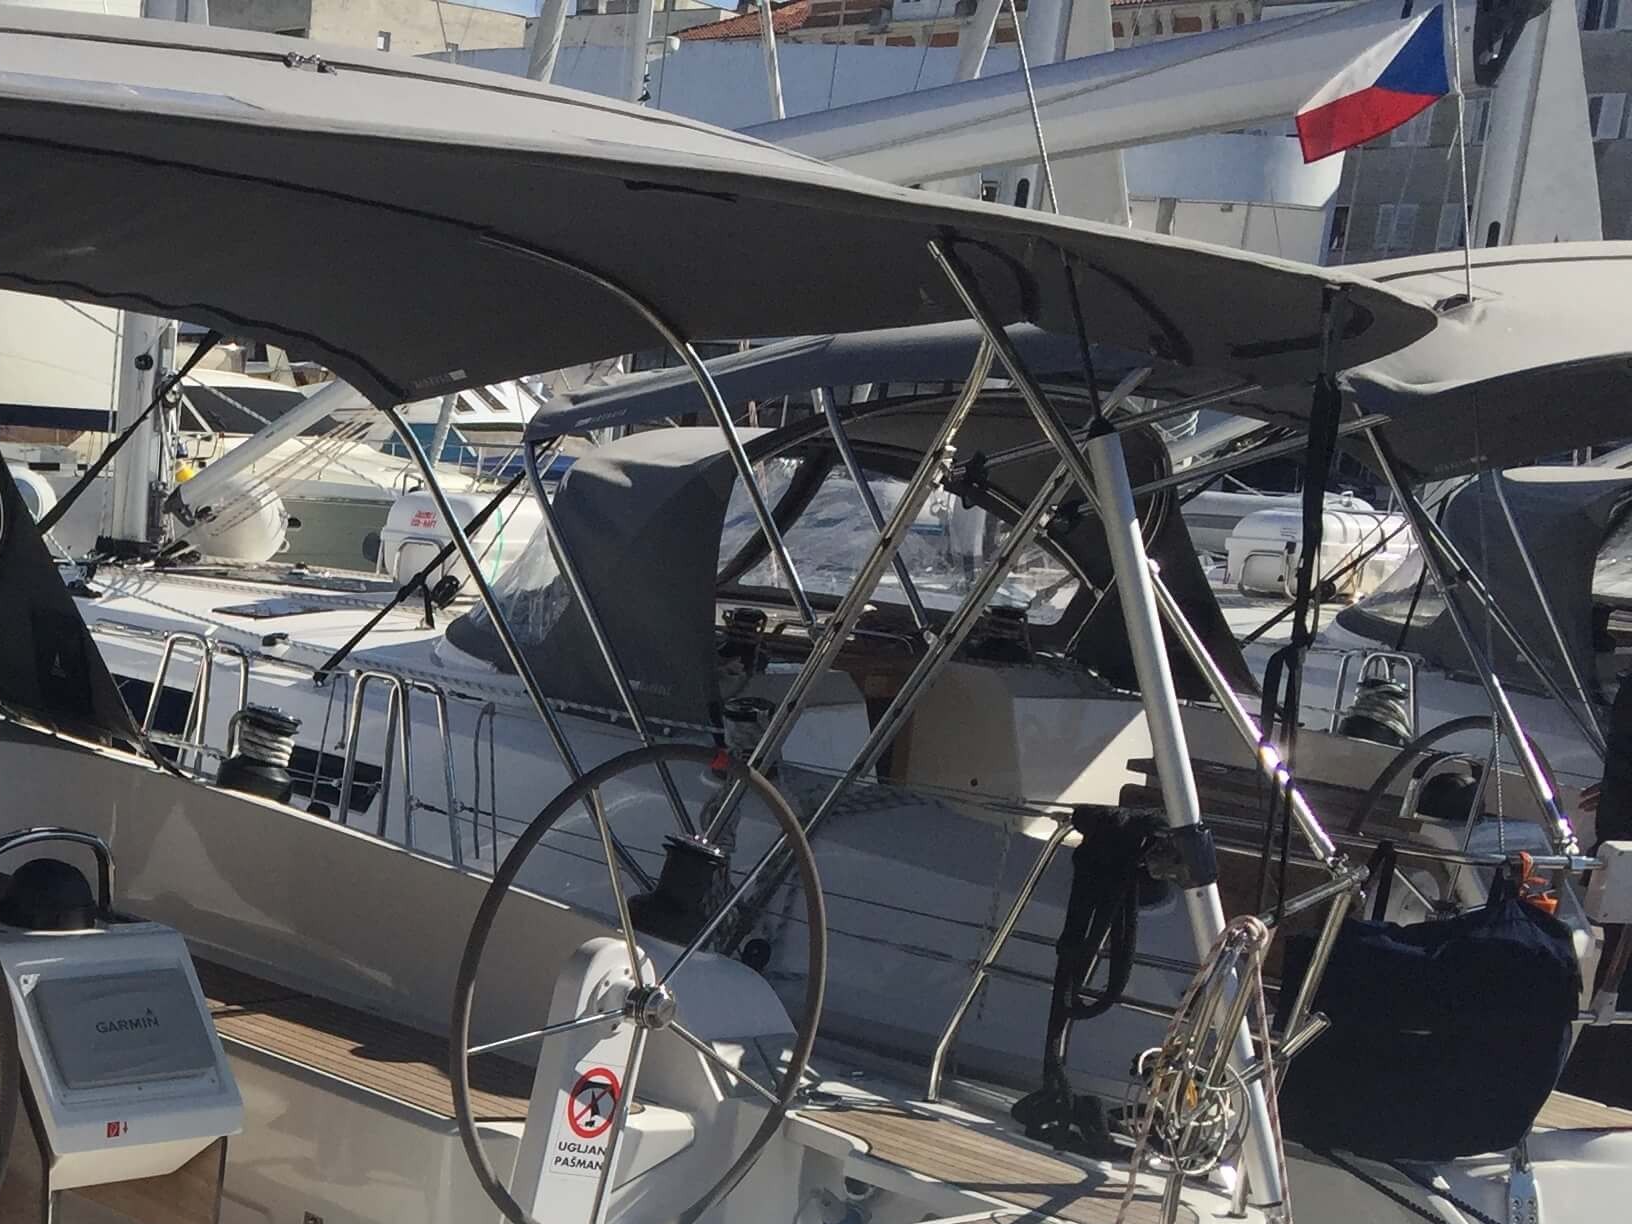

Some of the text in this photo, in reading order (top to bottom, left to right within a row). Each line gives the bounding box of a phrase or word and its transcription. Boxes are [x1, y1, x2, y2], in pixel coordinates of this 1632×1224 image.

[95, 1015, 160, 1033] GARMIN
[558, 1141, 608, 1156] UGLJAN
[554, 1155, 603, 1171] PAŠMAN
